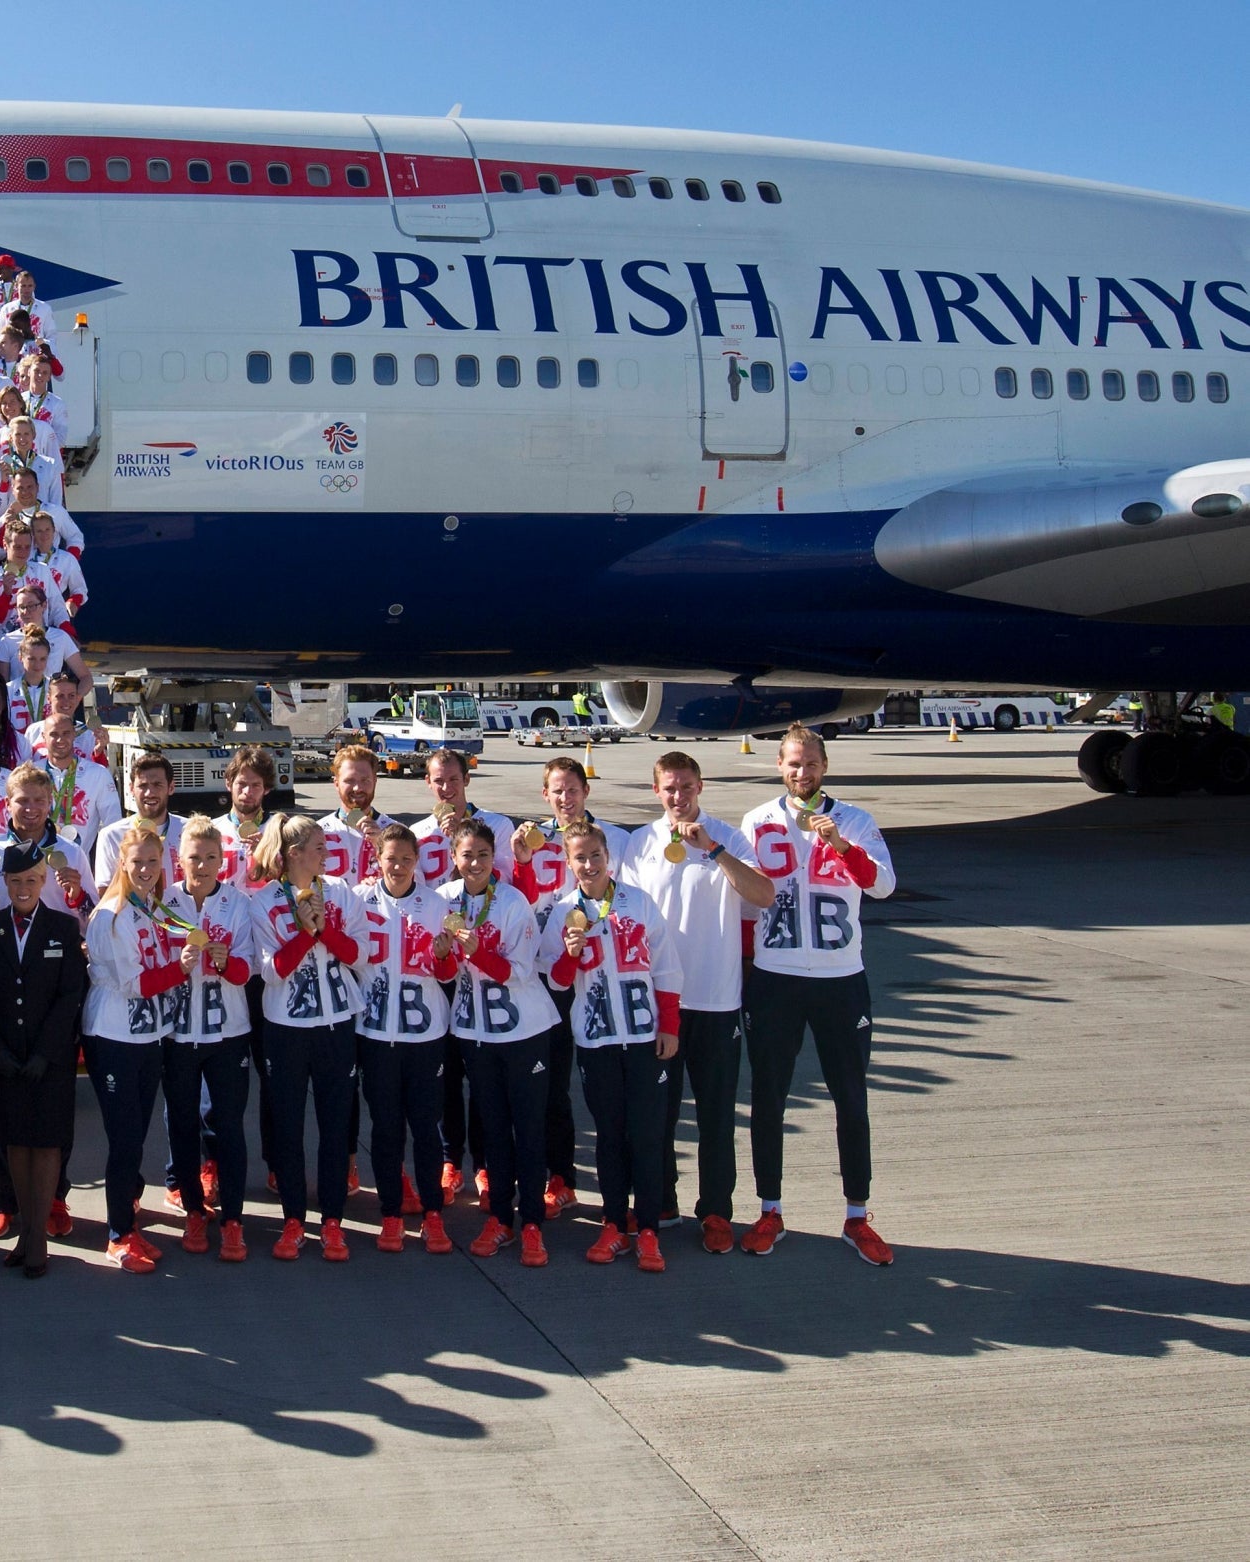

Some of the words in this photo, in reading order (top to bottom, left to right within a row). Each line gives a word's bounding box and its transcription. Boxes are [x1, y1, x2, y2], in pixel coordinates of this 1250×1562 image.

[291, 248, 780, 338] BRITISH
[810, 267, 1250, 353] AIRWAYS
[114, 466, 171, 477] AIRWAYS
[117, 454, 170, 465] BRITISH
[206, 455, 305, 471] victoRIOus
[316, 460, 346, 469] TEAM
[348, 460, 365, 470] GB
[207, 749, 230, 758] TLD
[419, 835, 448, 880] G
[755, 823, 799, 879] G
[810, 893, 854, 950] B
[202, 981, 228, 1035] B
[399, 982, 432, 1034] B
[481, 981, 520, 1034] B
[621, 980, 655, 1035] B
